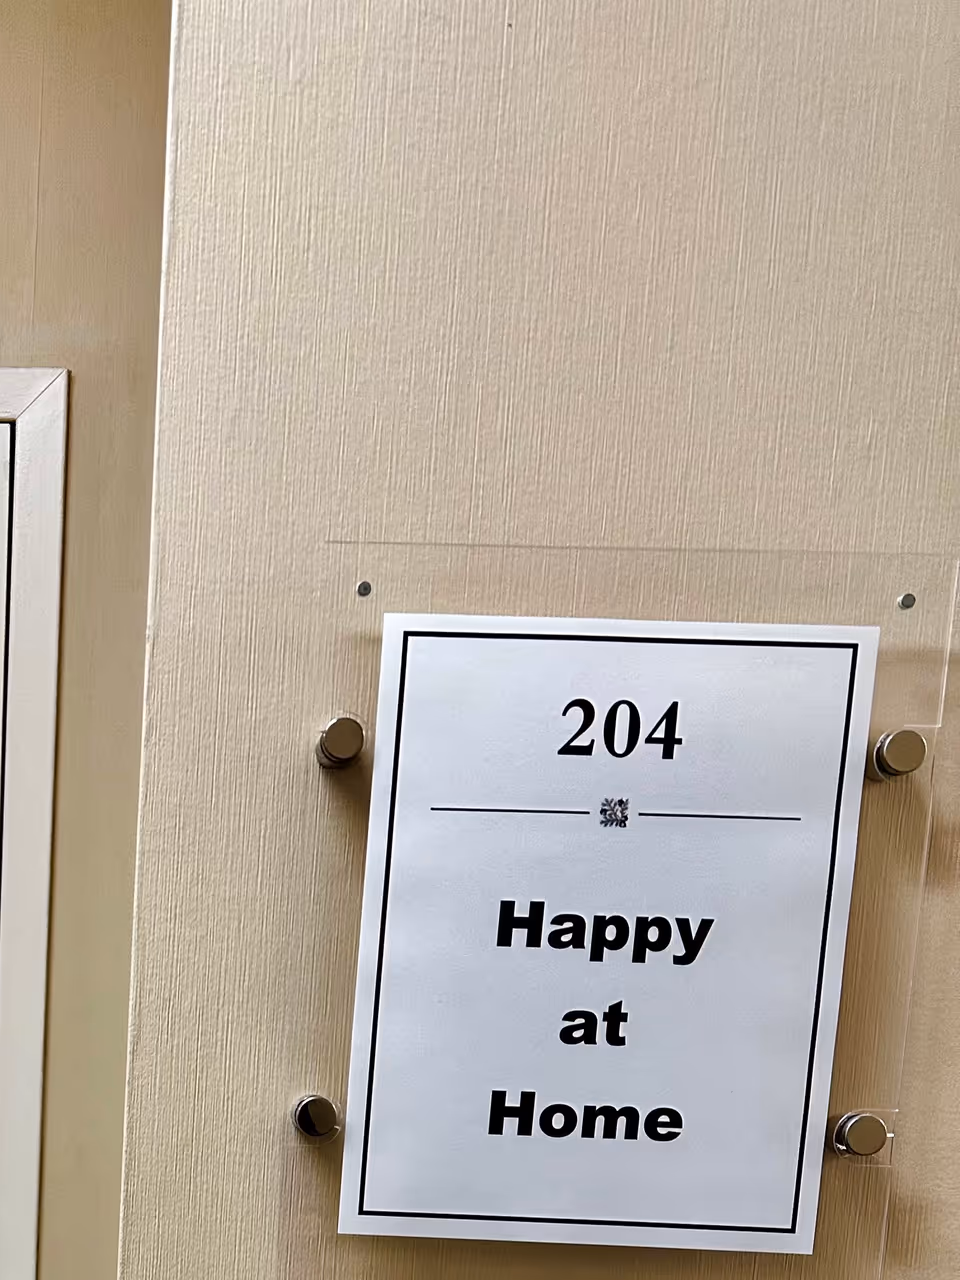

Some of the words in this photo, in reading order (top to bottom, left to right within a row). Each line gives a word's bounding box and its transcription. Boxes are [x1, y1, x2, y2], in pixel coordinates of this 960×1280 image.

[557, 698, 683, 760] 204
[496, 900, 715, 966] Happy
[559, 1000, 628, 1047] at
[488, 1090, 684, 1142] Home
